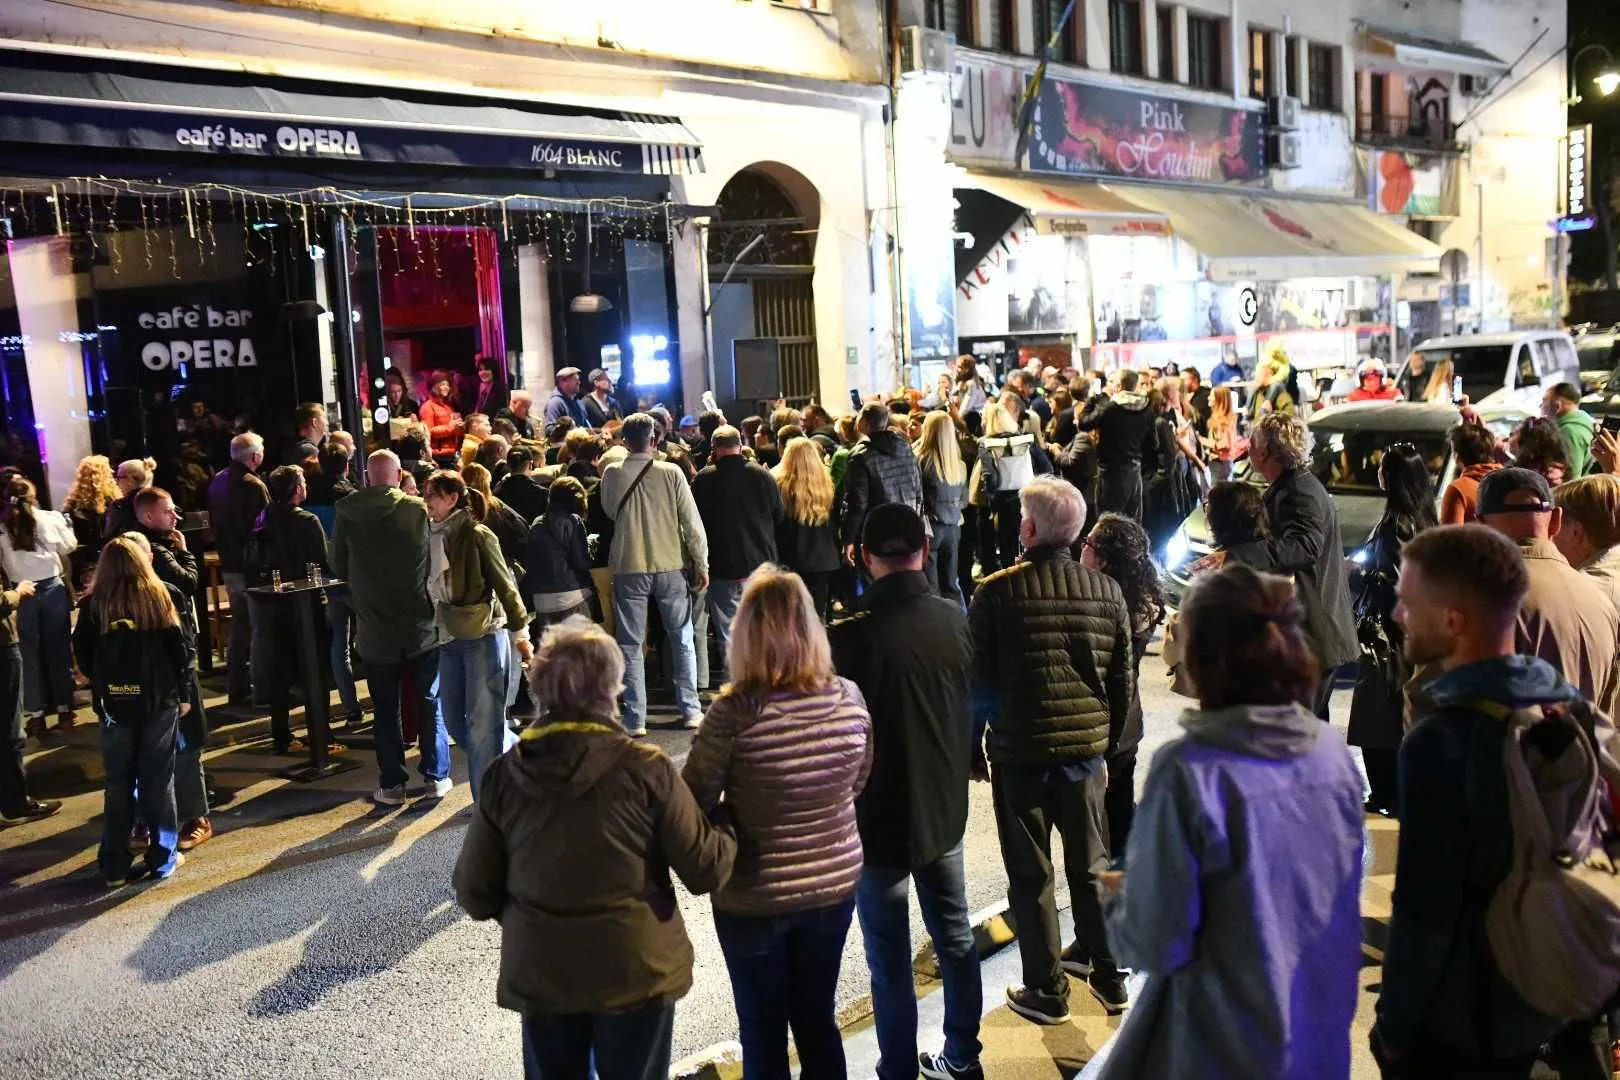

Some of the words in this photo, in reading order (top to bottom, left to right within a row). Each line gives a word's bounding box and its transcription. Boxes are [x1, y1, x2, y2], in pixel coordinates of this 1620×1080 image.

[1140, 101, 1186, 133] Pink
[176, 124, 226, 147] café
[230, 127, 268, 149] bar
[276, 126, 361, 155] OPERA
[531, 143, 564, 164] 1664
[567, 147, 622, 167] BLANC
[206, 305, 253, 328] bar
[141, 338, 258, 371] OPERA
